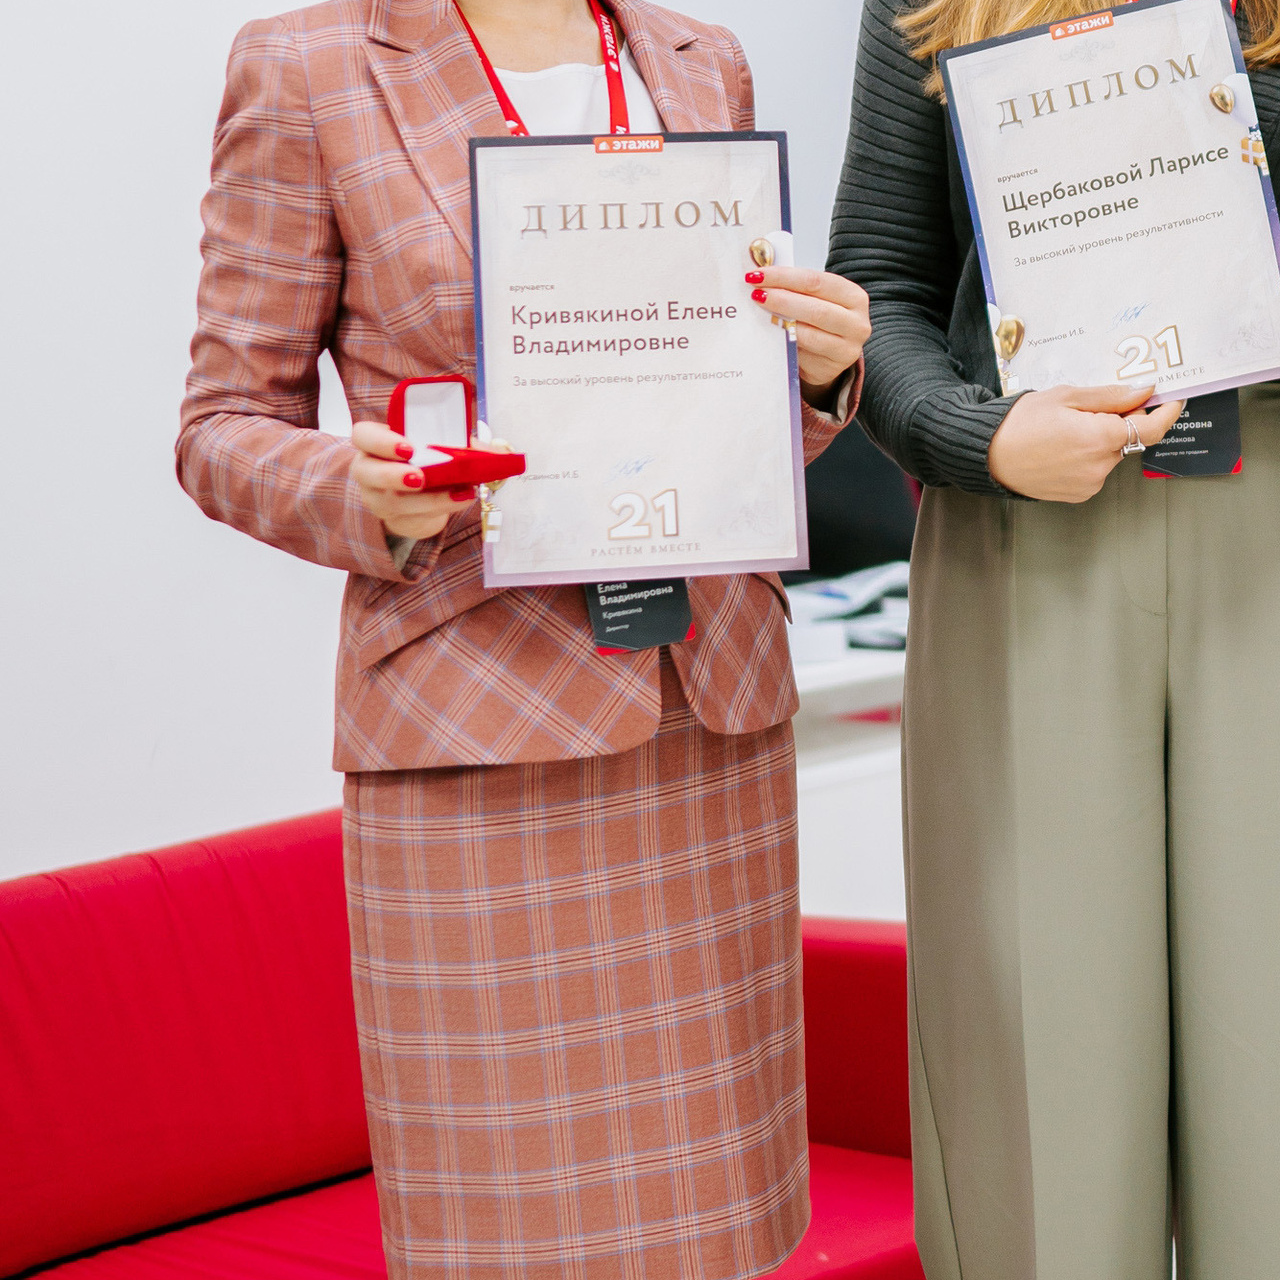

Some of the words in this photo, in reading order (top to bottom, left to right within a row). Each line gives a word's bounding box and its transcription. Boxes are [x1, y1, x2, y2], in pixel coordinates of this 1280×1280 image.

[1066, 15, 1110, 34] этажи
[600, 14, 616, 58] этажи
[997, 54, 1200, 134] ДИПЛОМ
[612, 138, 660, 151] этажи
[997, 167, 1039, 183] вручается
[1002, 162, 1143, 213] Щербаковой
[1149, 146, 1229, 176] Ларисе
[520, 199, 744, 240] ДИПЛОМ
[1007, 196, 1139, 239] Викторовне
[1013, 256, 1027, 267] За
[1029, 243, 1077, 263] высокий
[1078, 234, 1124, 254] уровень
[1126, 208, 1224, 242] результативности
[509, 284, 555, 293] вручается
[511, 302, 659, 329] Кривякиной
[667, 301, 738, 321] Елене
[512, 335, 690, 357] Владимировне
[1027, 333, 1068, 347] Хусаинов
[1114, 324, 1184, 381] 21
[513, 376, 527, 387] За
[530, 374, 582, 386] высокий
[584, 374, 634, 386] уровень
[636, 370, 744, 383] результативности
[1157, 366, 1206, 384] ВМЕСТЕ
[608, 488, 679, 541] 21
[591, 545, 643, 557] РАСТЁМ
[651, 542, 701, 554] ВМЕСТЕ
[597, 582, 628, 594] Елена
[599, 586, 674, 606] Владимировна
